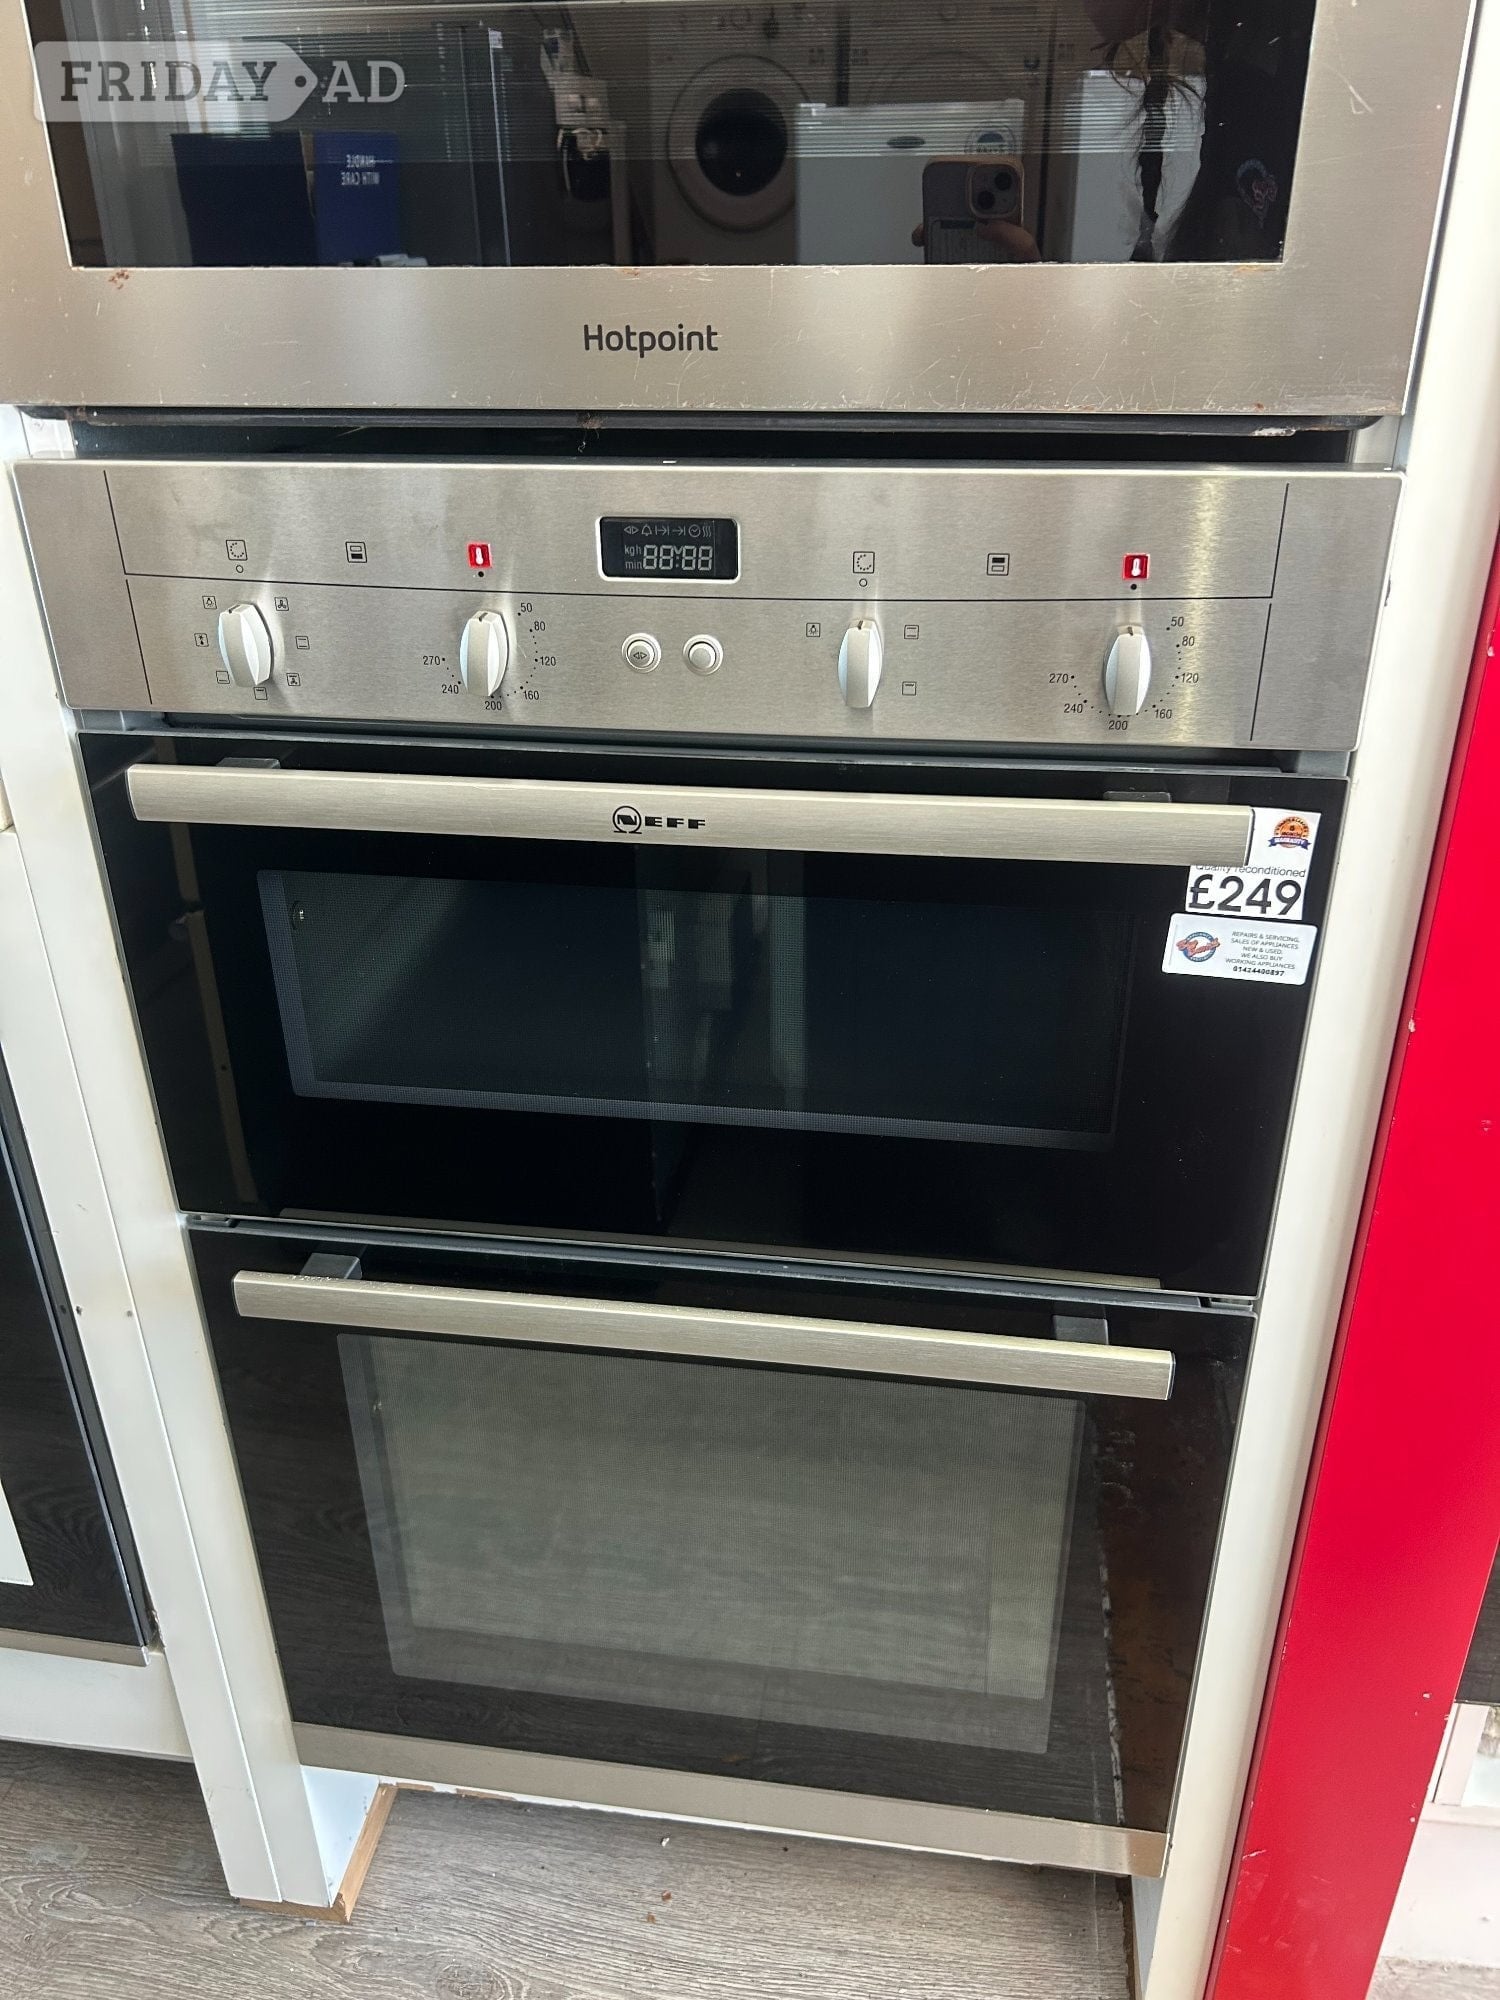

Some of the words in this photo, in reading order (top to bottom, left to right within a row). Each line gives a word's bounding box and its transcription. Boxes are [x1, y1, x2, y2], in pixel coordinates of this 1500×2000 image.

[584, 323, 718, 358] Hotpoint
[625, 561, 643, 570] min
[520, 603, 532, 612] 50
[534, 621, 546, 631] 80
[1171, 616, 1184, 627] 50
[1182, 636, 1195, 646] 80
[423, 656, 440, 665] 270
[540, 656, 556, 666] 120
[1049, 673, 1069, 684] 270
[1181, 673, 1199, 683] 120
[441, 684, 459, 694] 240
[523, 690, 539, 700] 160
[485, 701, 502, 710] 200
[1064, 704, 1083, 713] 240
[1155, 709, 1172, 719] 160
[1108, 720, 1128, 730] 200
[613, 806, 706, 834] NEFF
[1234, 865, 1306, 878] reconditioned
[1189, 874, 1301, 915] £249
[1232, 931, 1258, 939] REPAIRS
[1260, 941, 1299, 950] APPLIANCES
[1225, 958, 1256, 966] WORKING
[1257, 961, 1296, 970] APPLIANCES
